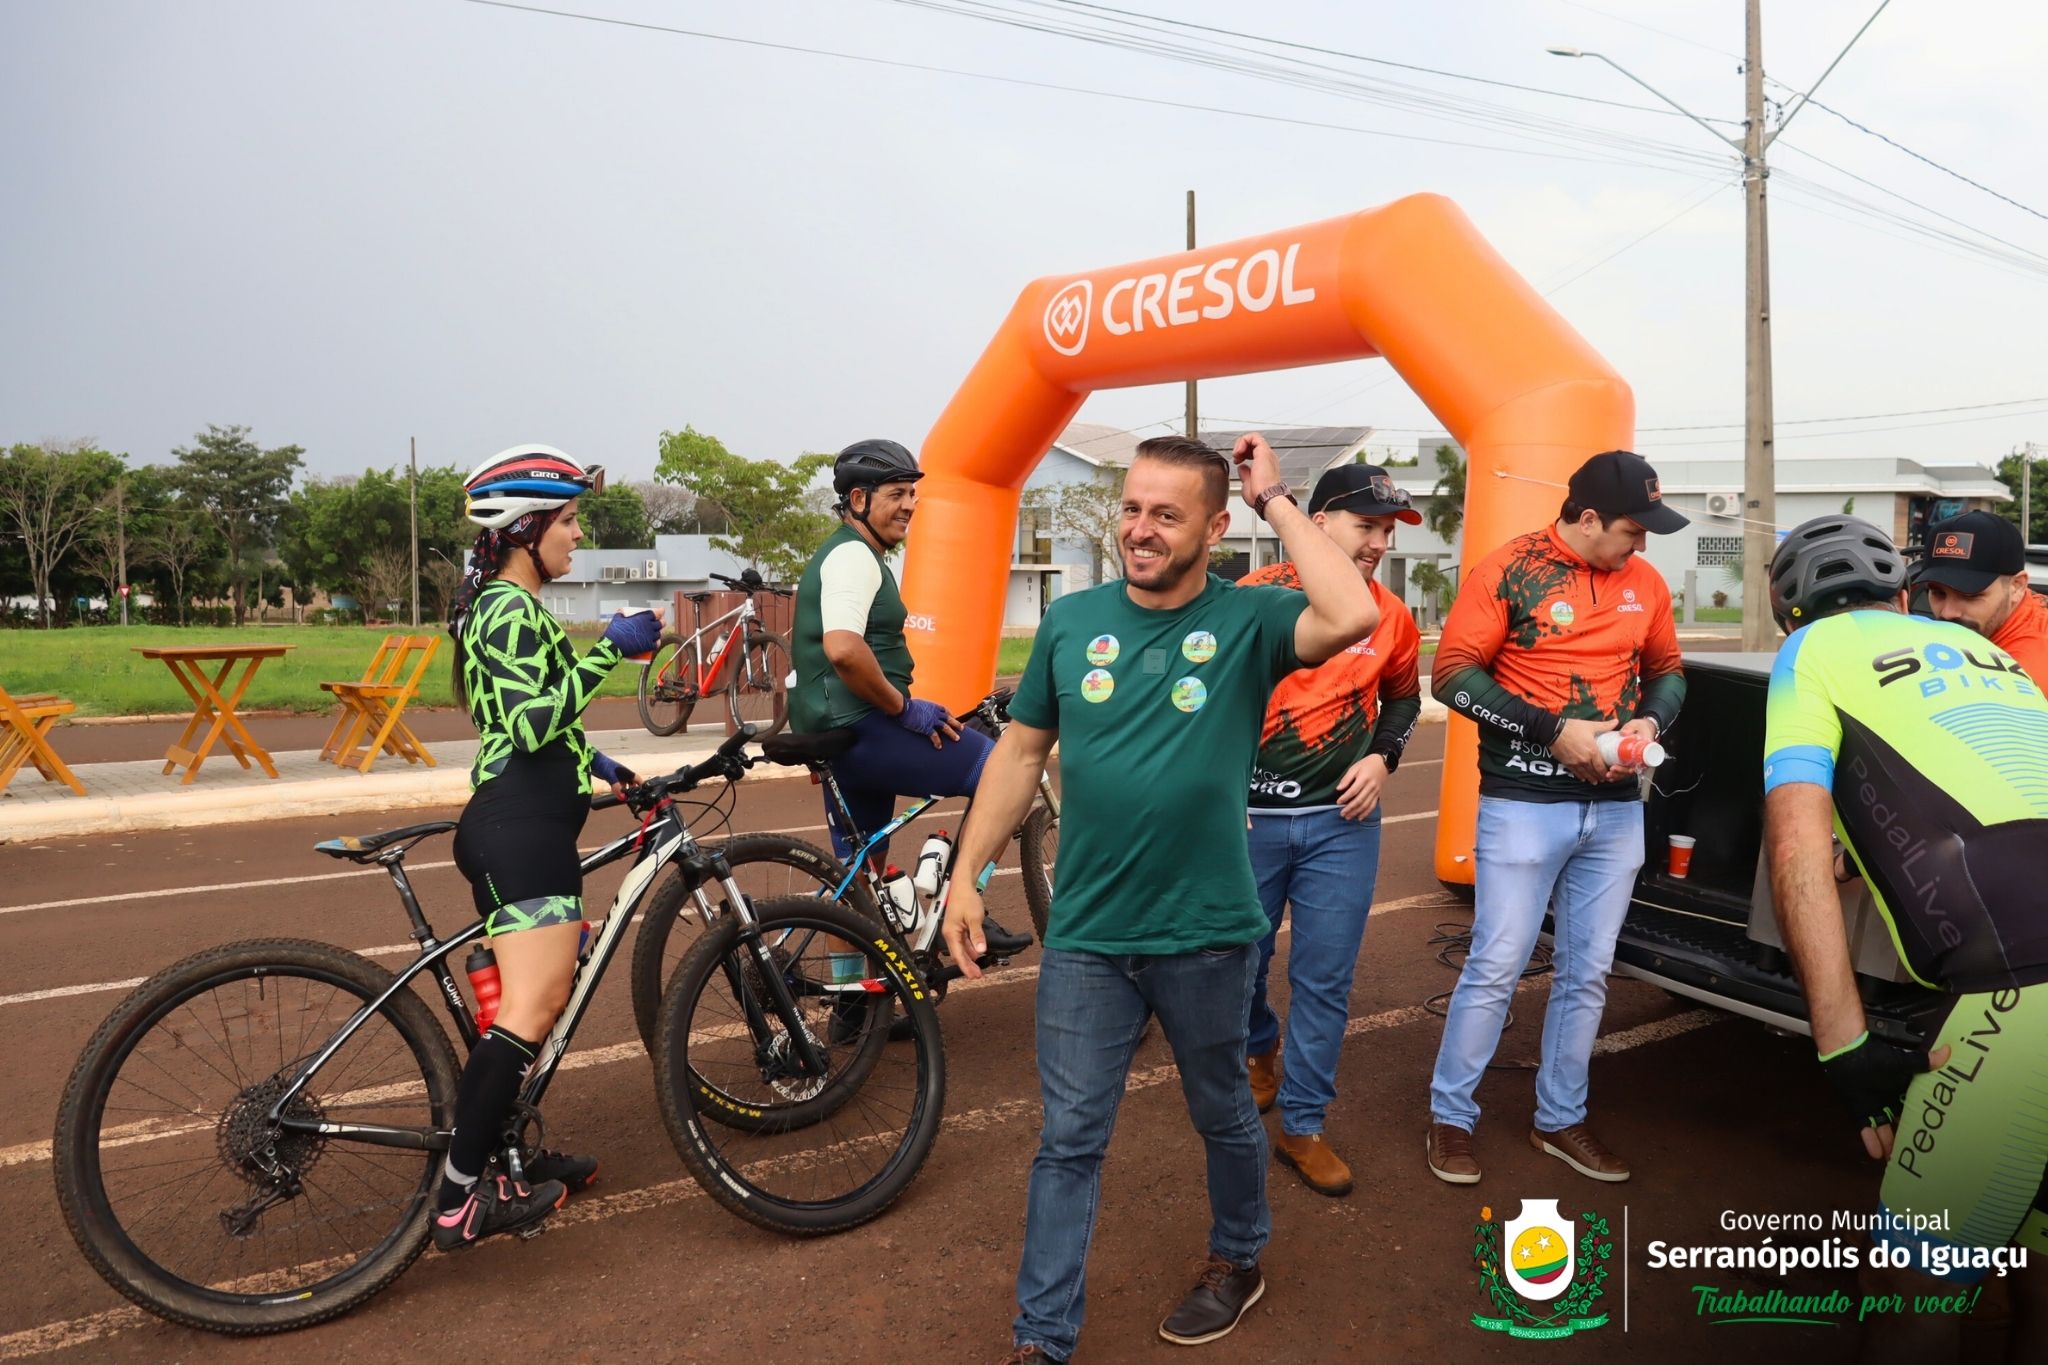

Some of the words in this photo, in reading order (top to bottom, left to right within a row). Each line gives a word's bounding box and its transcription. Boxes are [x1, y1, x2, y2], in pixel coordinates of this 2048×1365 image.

[1102, 243, 1316, 336] CRESOL
[530, 470, 560, 480] GIRO
[1935, 546, 1967, 556] CRESOL
[1918, 674, 2036, 698] BIKE
[1471, 704, 1525, 738] CRESOL
[1849, 755, 1962, 948] PedalLive
[873, 938, 924, 1001] MAXXIS
[442, 975, 465, 1008] COMP
[1898, 987, 2021, 1179] PedalLive
[700, 1086, 762, 1118] MAXXIS
